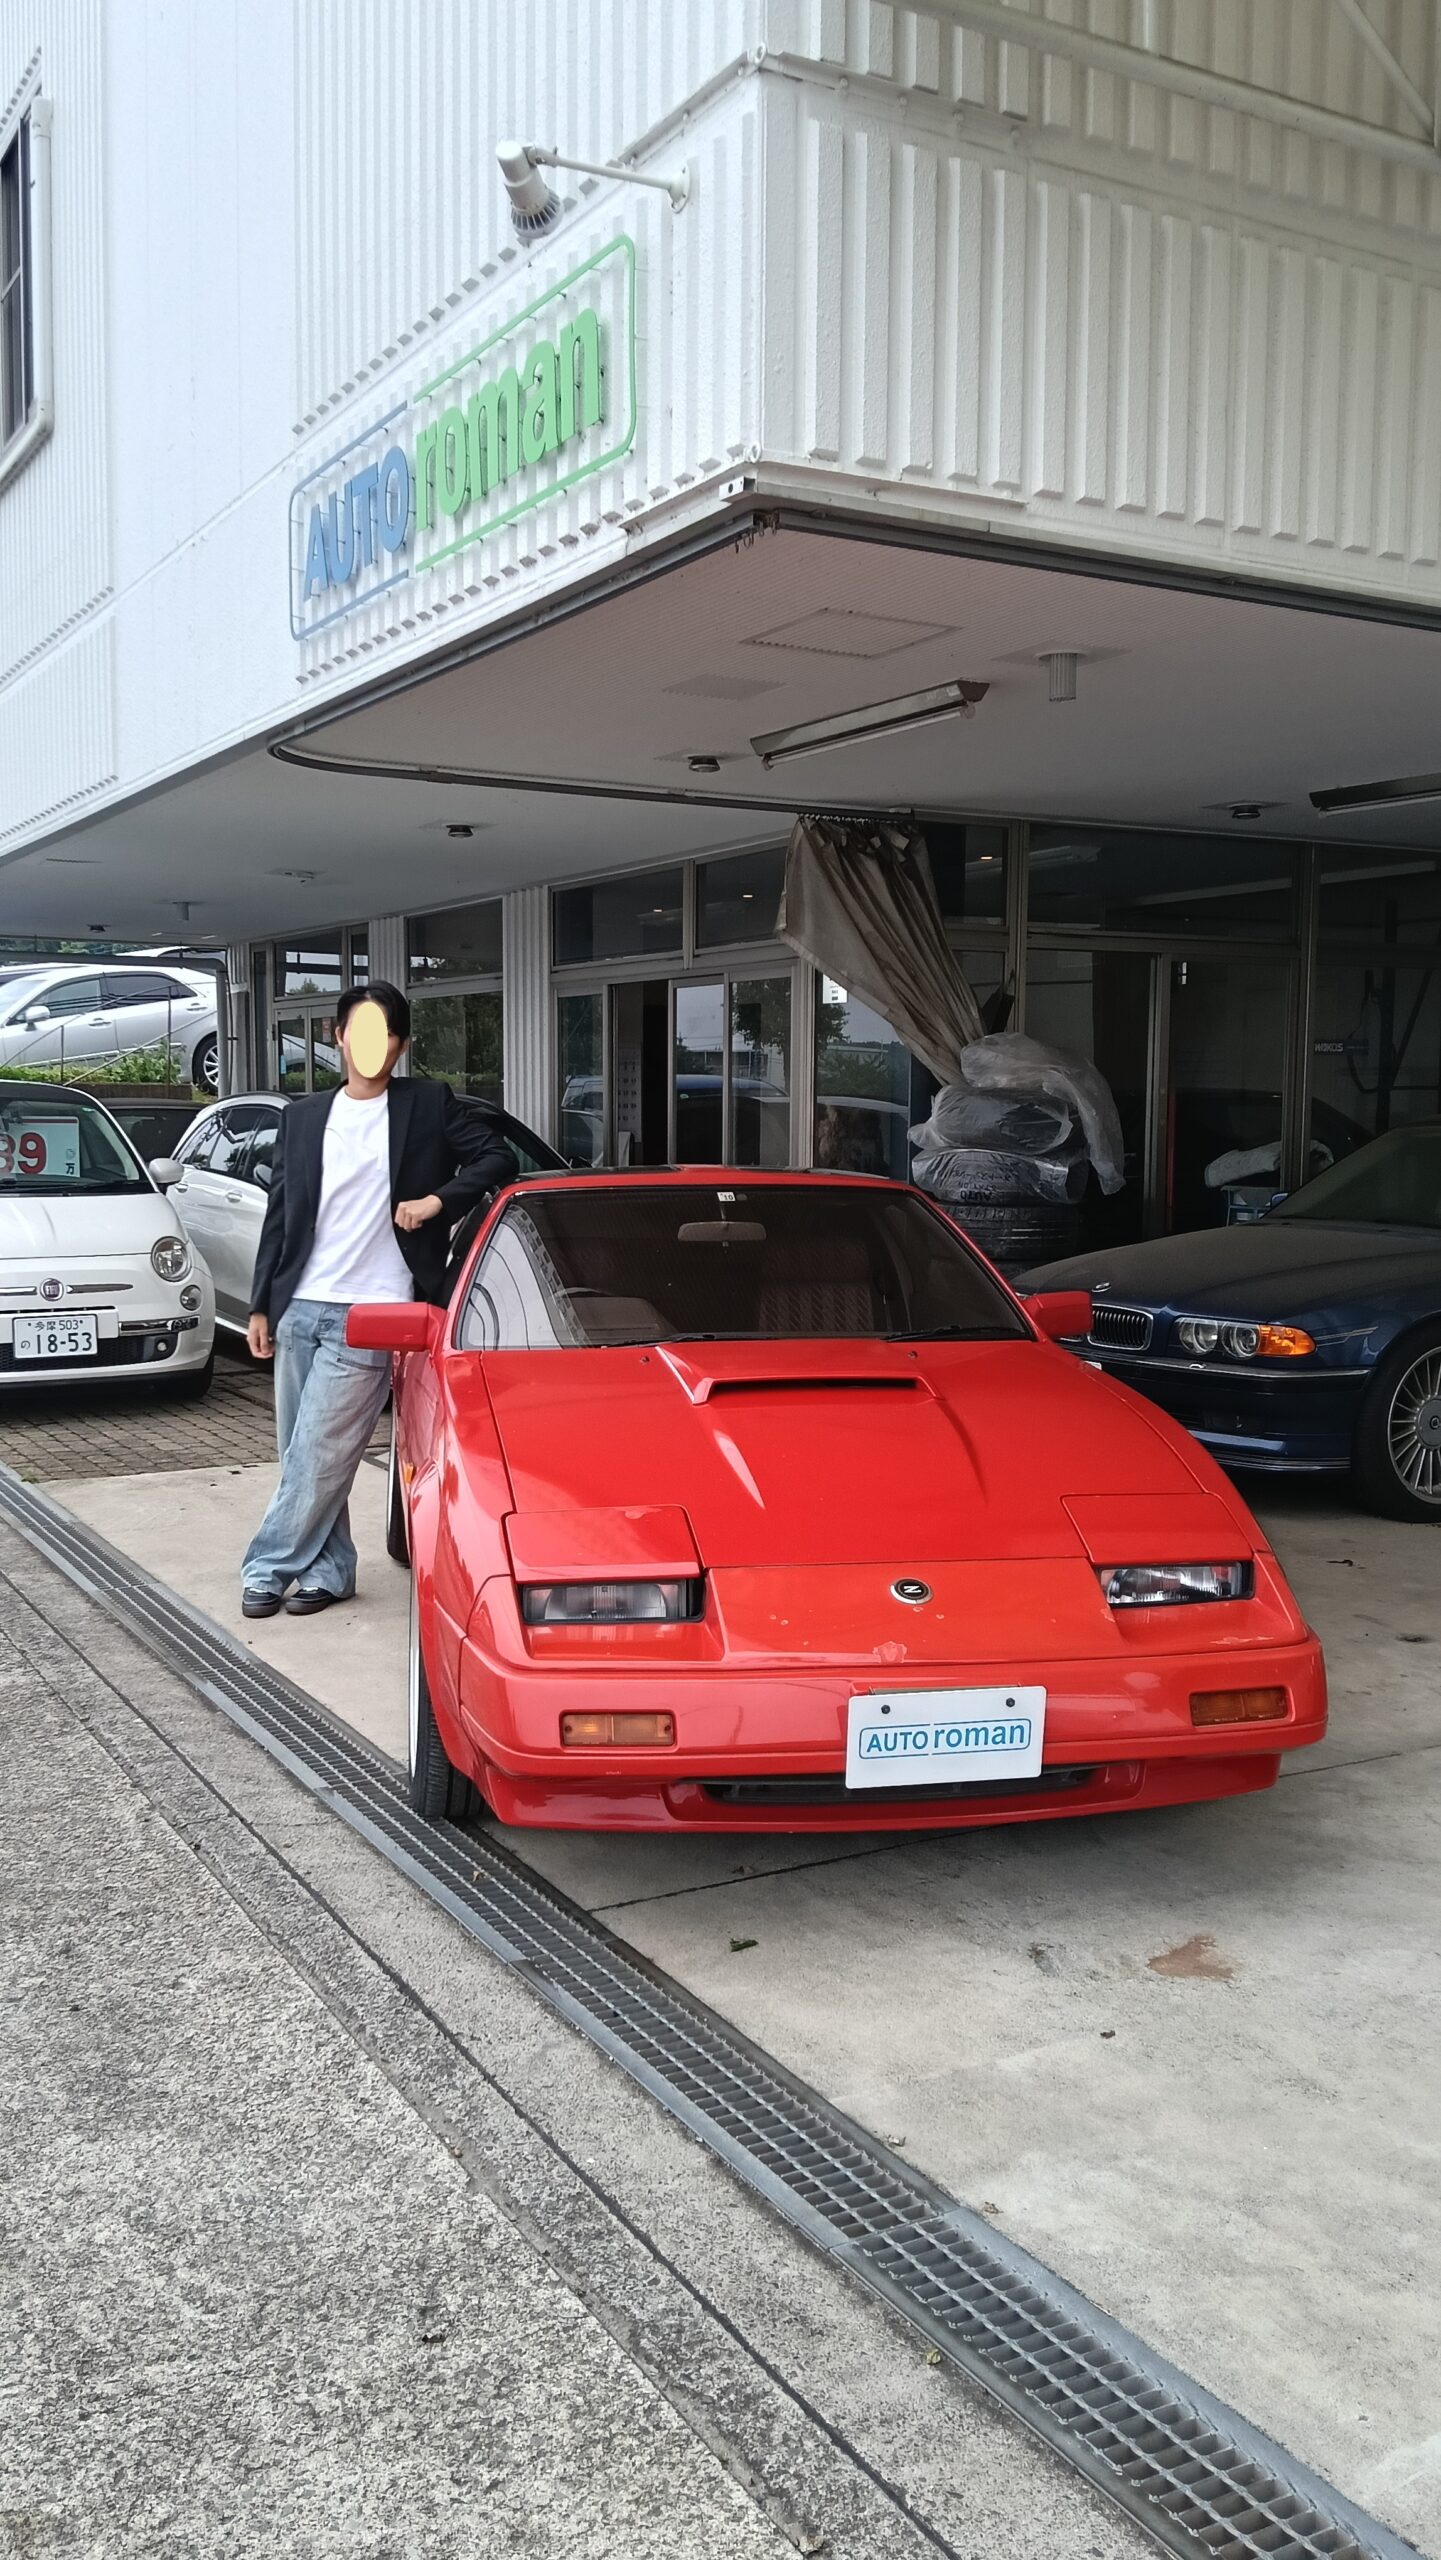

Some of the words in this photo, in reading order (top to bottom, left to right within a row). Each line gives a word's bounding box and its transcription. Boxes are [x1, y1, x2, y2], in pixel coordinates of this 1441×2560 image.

[303, 446, 410, 602] AUTO
[415, 308, 602, 533] roman
[960, 1190, 993, 1201] AUTO
[58, 1319, 79, 1331] 503
[20, 1340, 31, 1350] の
[36, 1332, 92, 1354] 18-53
[866, 1730, 929, 1753] AUTO
[934, 1724, 1025, 1749] roman
